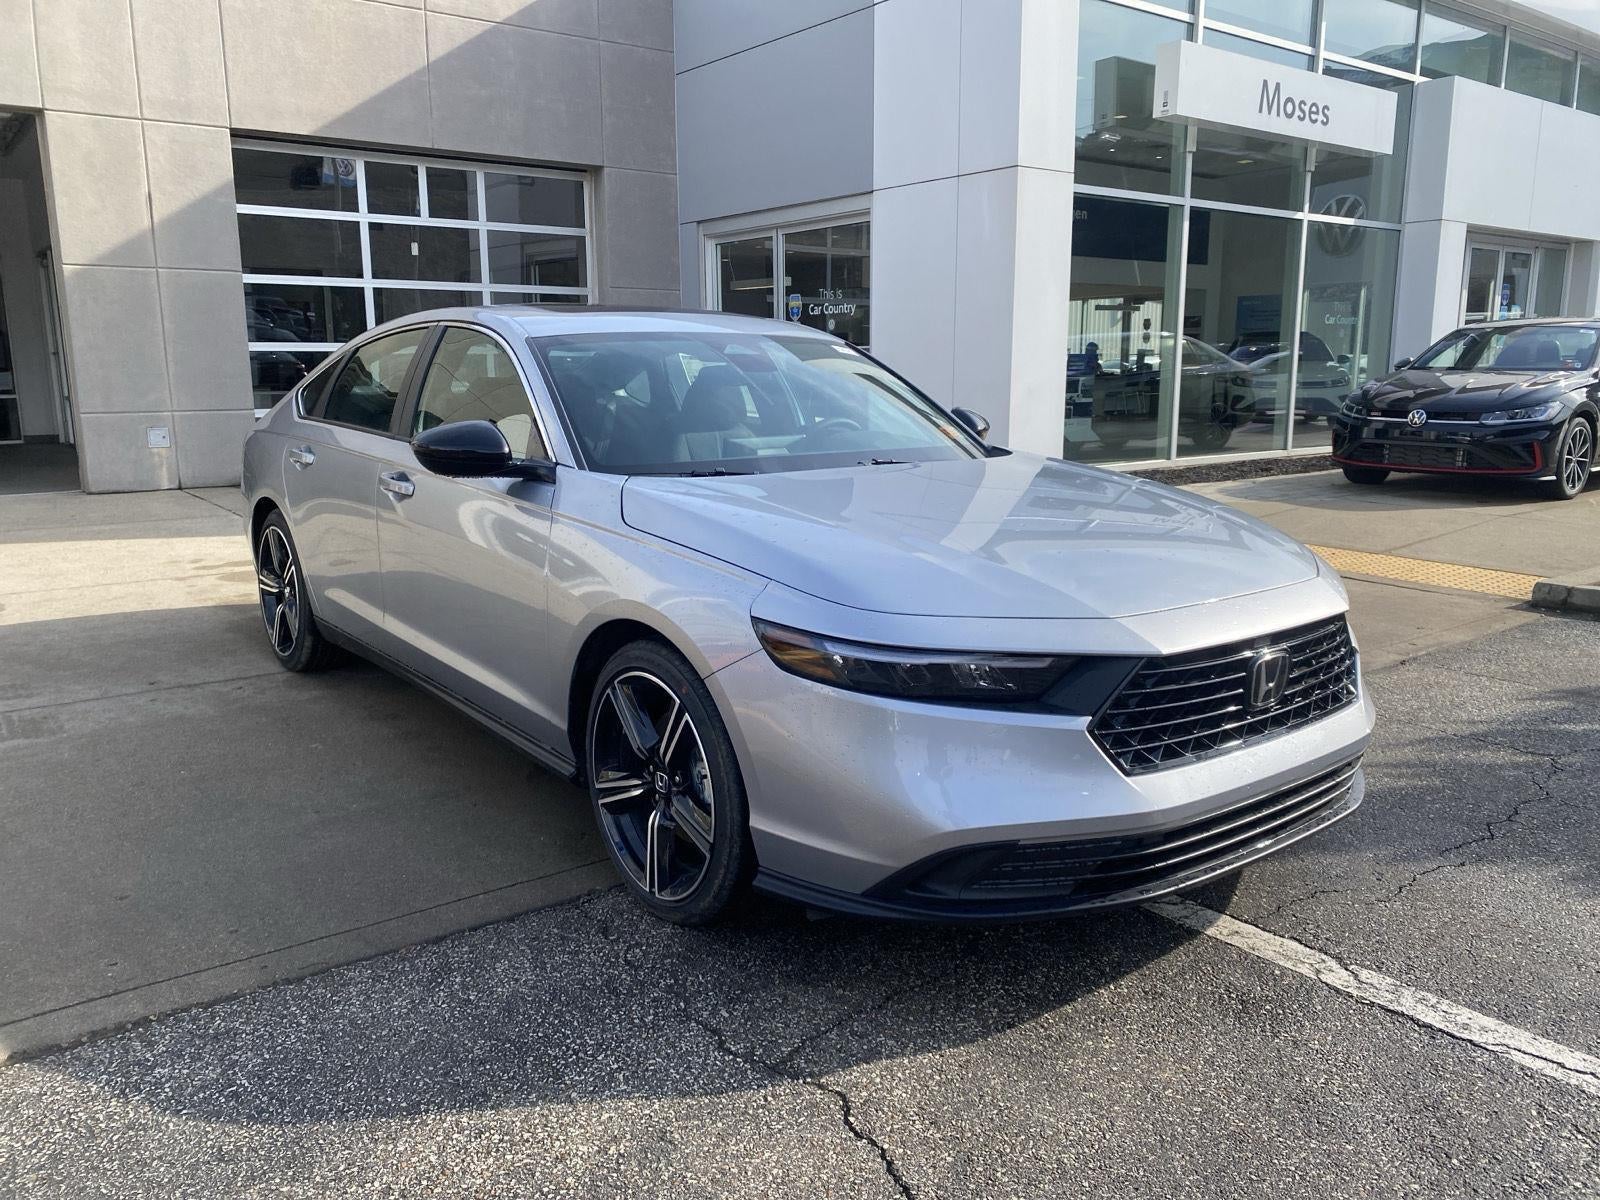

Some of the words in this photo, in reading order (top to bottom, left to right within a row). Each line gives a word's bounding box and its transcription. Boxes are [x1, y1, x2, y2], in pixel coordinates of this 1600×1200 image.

[1258, 78, 1330, 126] Moses
[819, 288, 834, 300] This
[836, 287, 843, 299] is
[808, 303, 821, 315] Car
[823, 302, 856, 316] Country
[1324, 313, 1335, 325] Car
